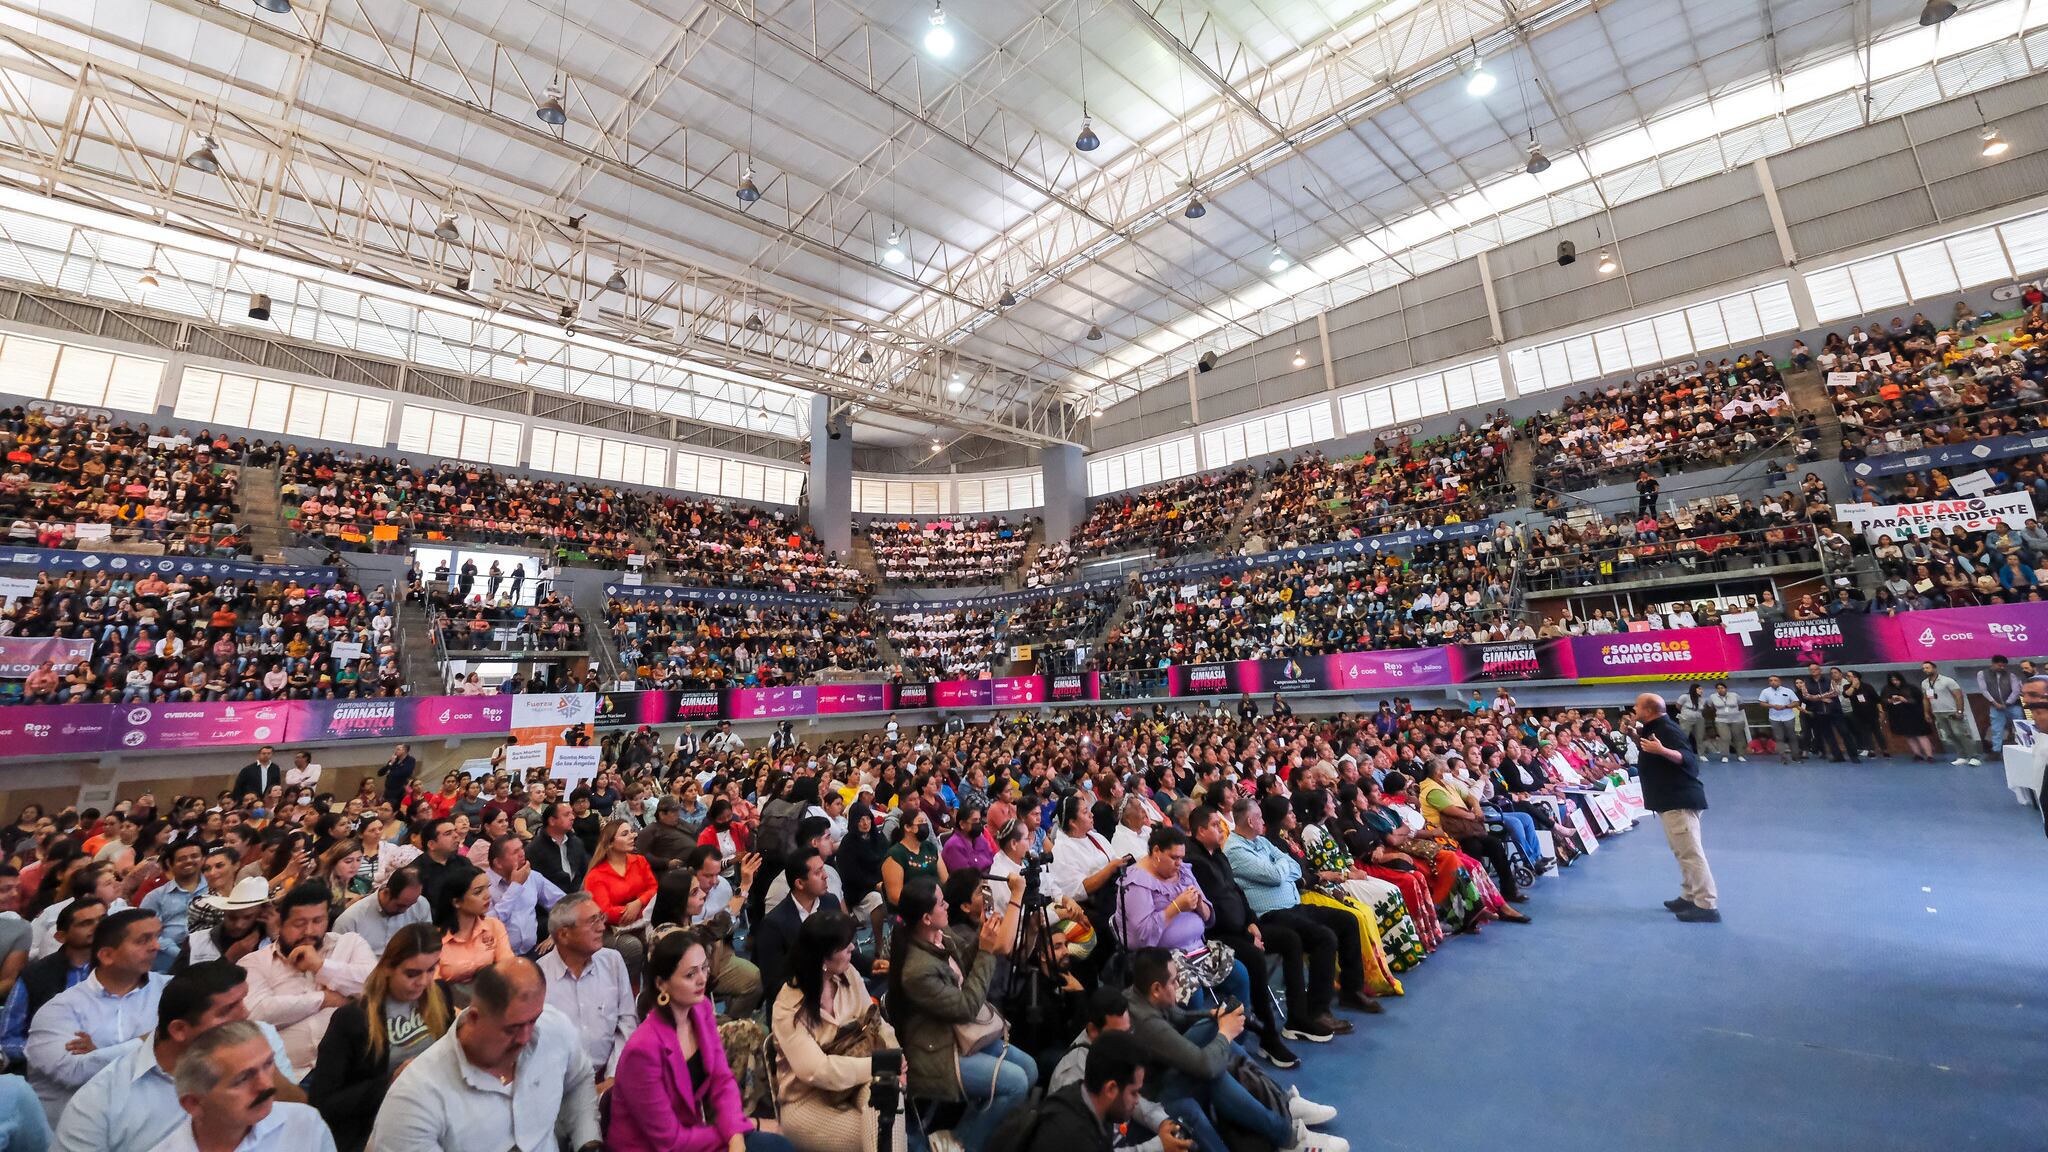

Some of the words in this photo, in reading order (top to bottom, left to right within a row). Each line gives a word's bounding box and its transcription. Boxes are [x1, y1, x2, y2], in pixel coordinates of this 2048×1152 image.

[1861, 516, 1910, 530] PARA
[1914, 504, 2029, 525] PRESIDENTE
[1774, 624, 1840, 639] GIMNASIA
[1942, 632, 1974, 641] CODE
[1601, 640, 1690, 655] #SOMOSLOS
[1482, 650, 1537, 662] GIMNASIA
[1602, 650, 1692, 665] CAMPEONES
[13, 664, 40, 672] CON
[1190, 670, 1226, 680] GIMNASIA
[680, 697, 718, 706] GIMNASIA
[333, 707, 395, 720] GIMNASIA
